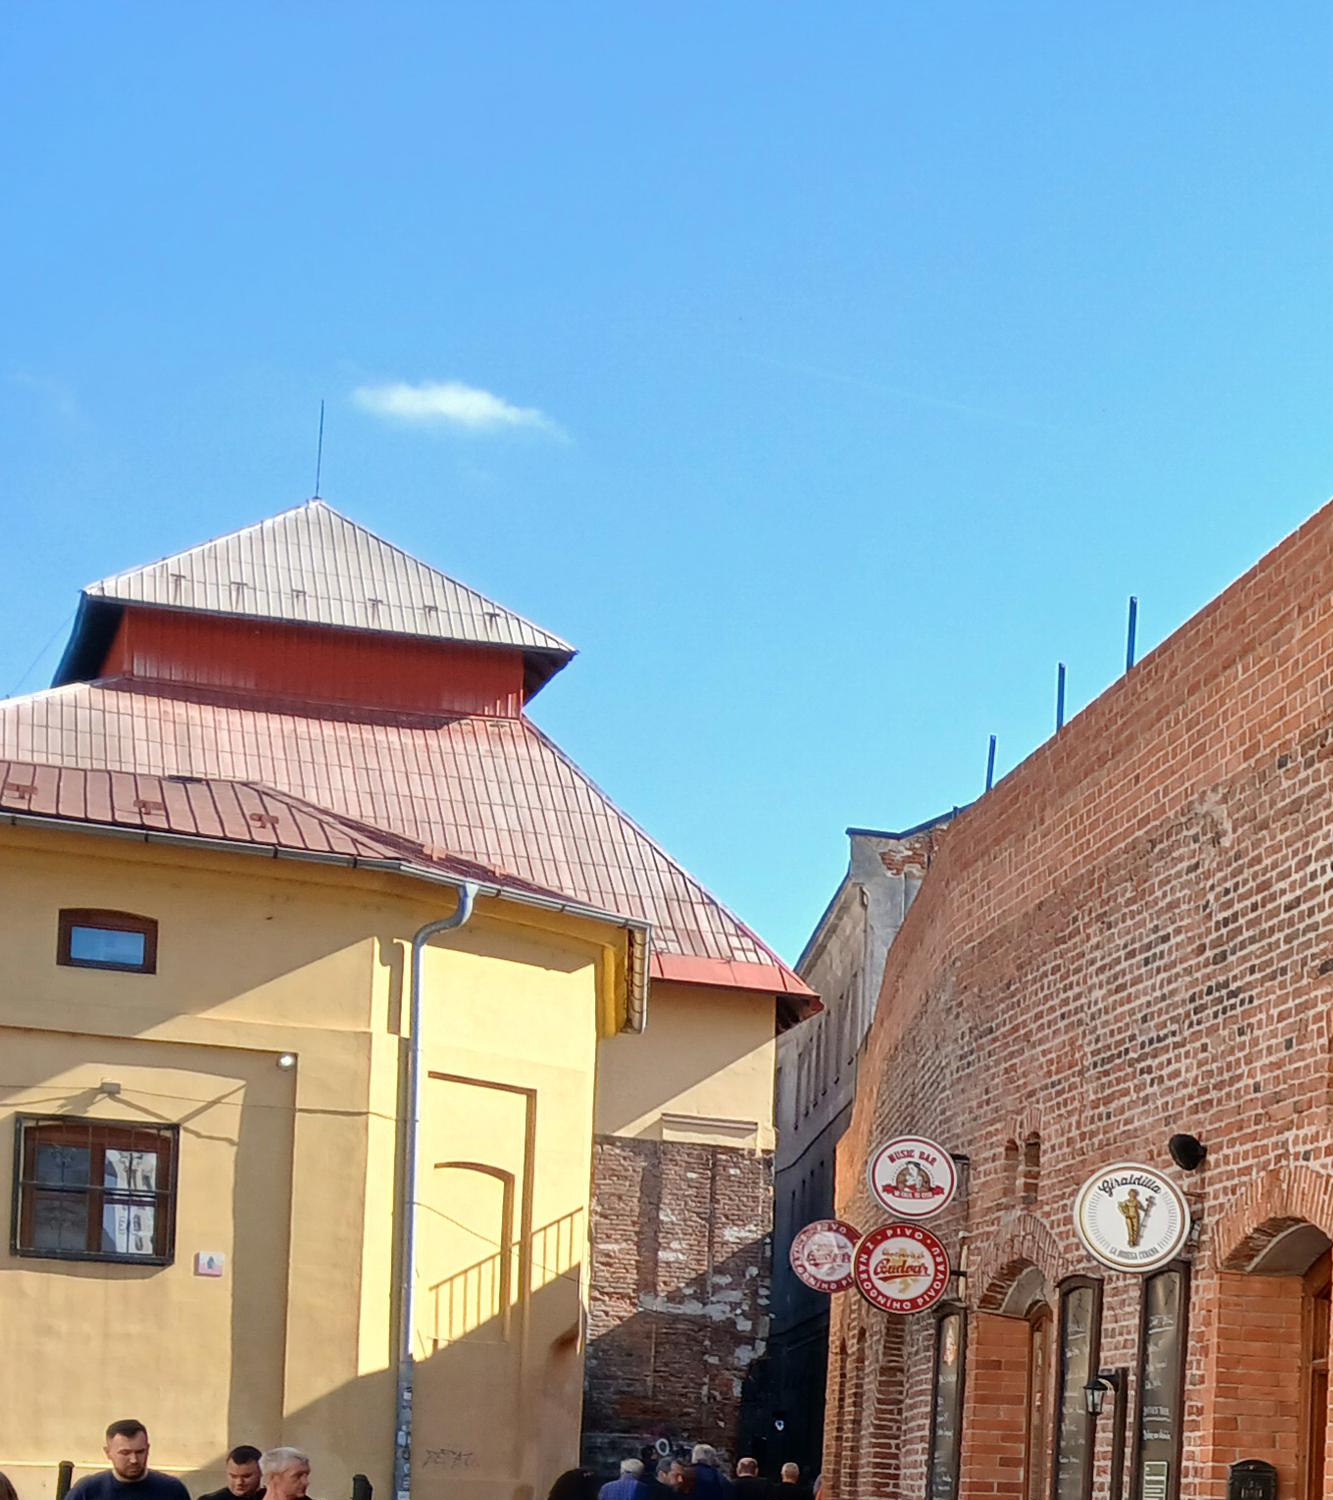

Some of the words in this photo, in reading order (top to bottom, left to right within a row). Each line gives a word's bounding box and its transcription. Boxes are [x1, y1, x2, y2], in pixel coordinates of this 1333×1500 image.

[1097, 1173, 1162, 1198] Giraldilla
[886, 1227, 924, 1241] PIVO
[873, 1257, 932, 1279] Budvar
